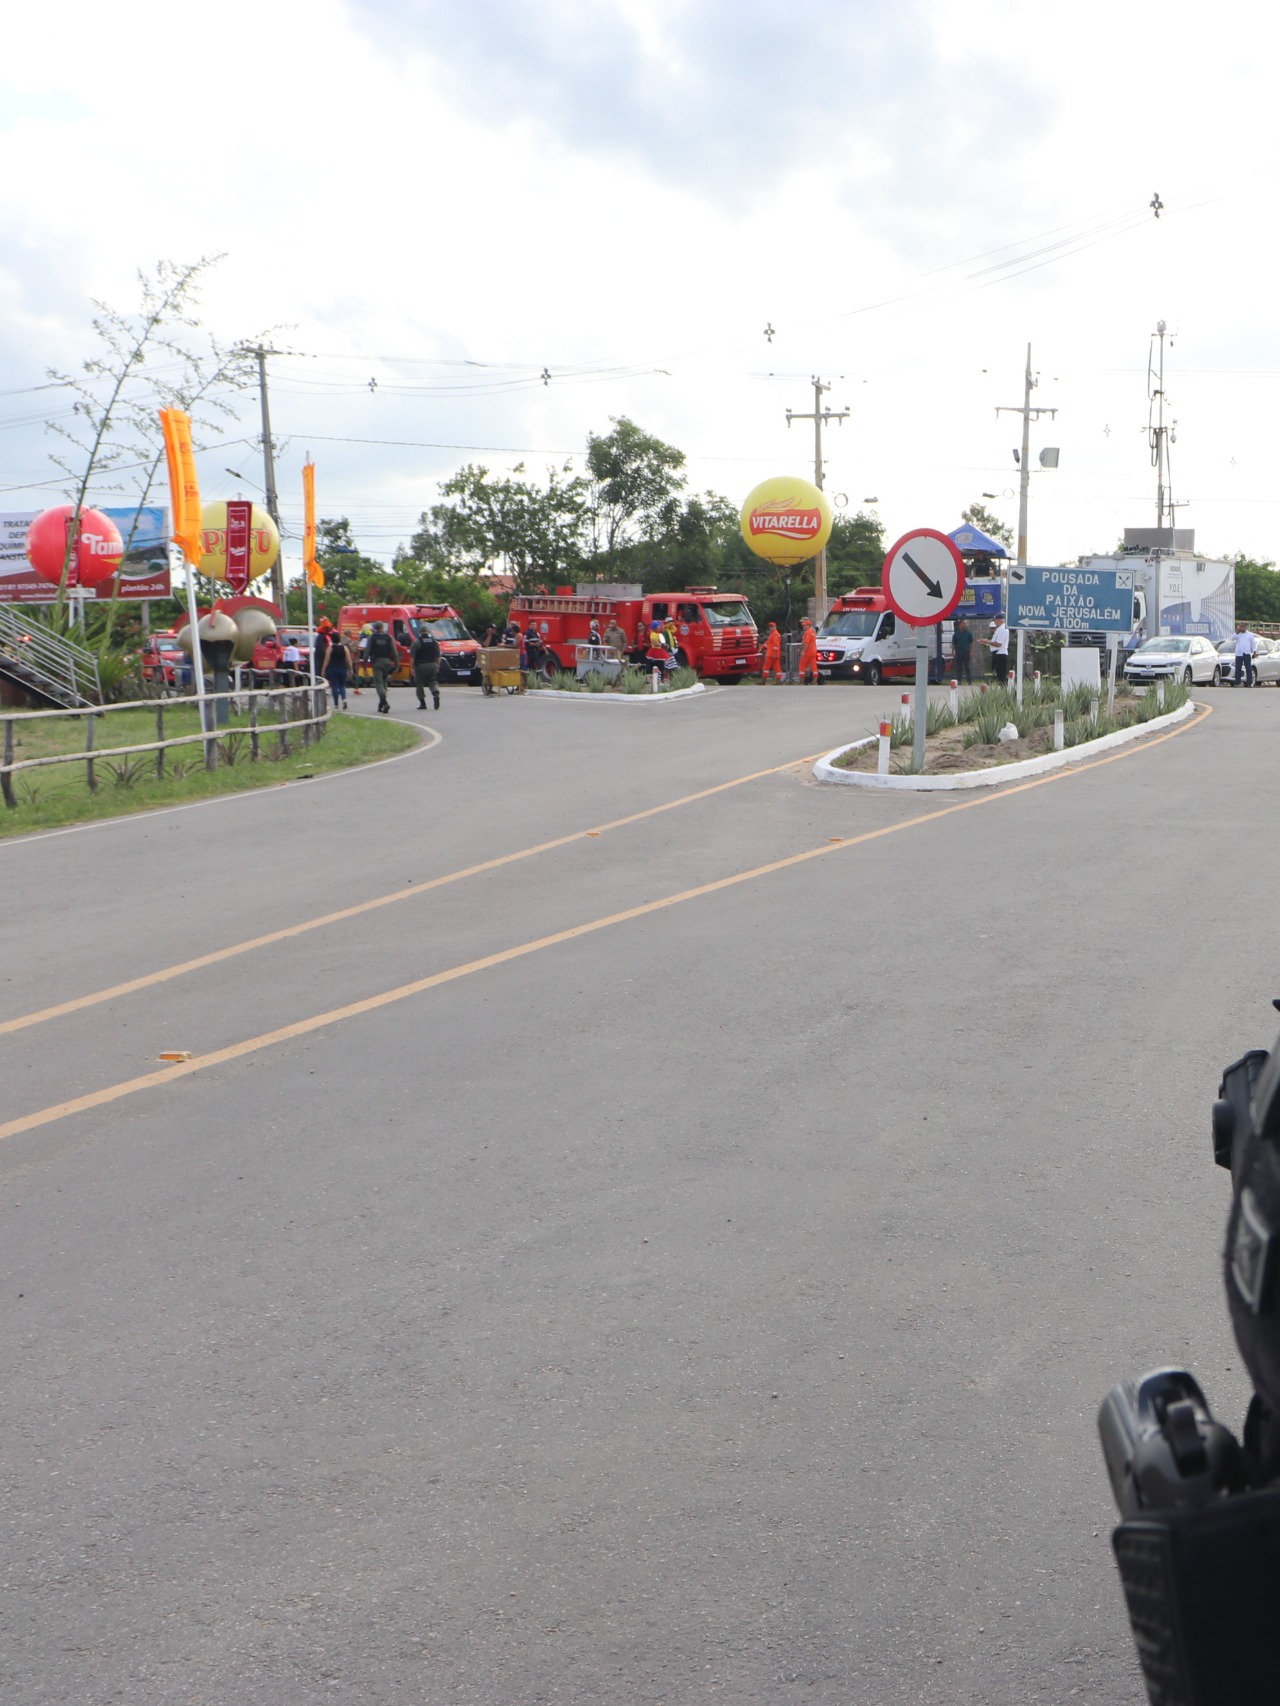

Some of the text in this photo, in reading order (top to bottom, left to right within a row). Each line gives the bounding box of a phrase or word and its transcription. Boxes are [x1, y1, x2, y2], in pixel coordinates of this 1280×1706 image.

[3, 520, 32, 529] TRATA
[752, 515, 818, 529] VITARELLA
[81, 532, 124, 556] Tam
[1042, 571, 1100, 585] POUSADA
[1063, 584, 1078, 596] DA
[1046, 594, 1095, 607] PAIXÃO
[1018, 605, 1121, 620] NOVA JERUSALÉM
[1063, 618, 1089, 629] 100m
